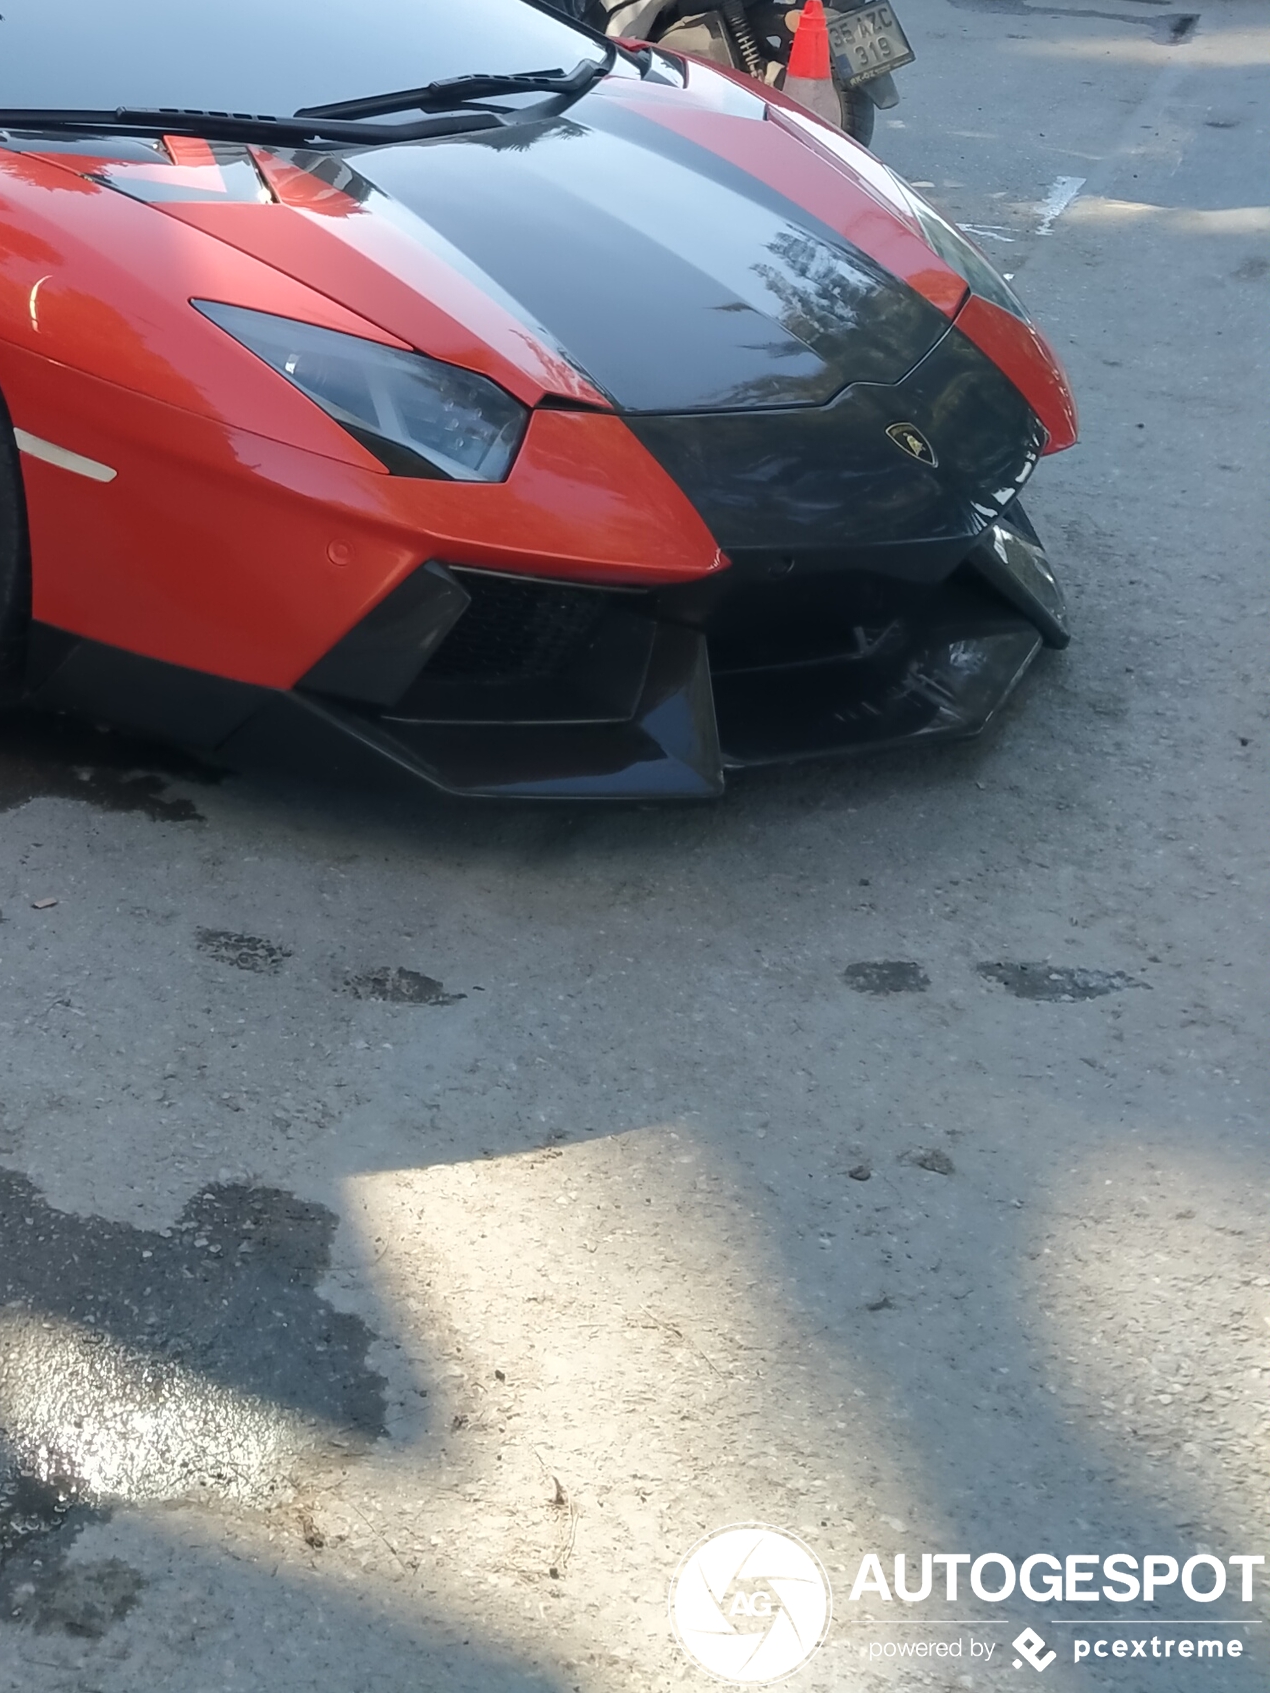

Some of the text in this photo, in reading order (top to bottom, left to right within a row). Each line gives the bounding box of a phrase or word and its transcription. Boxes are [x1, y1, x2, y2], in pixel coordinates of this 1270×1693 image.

[829, 7, 893, 48] 35 AZC
[853, 35, 891, 66] 319
